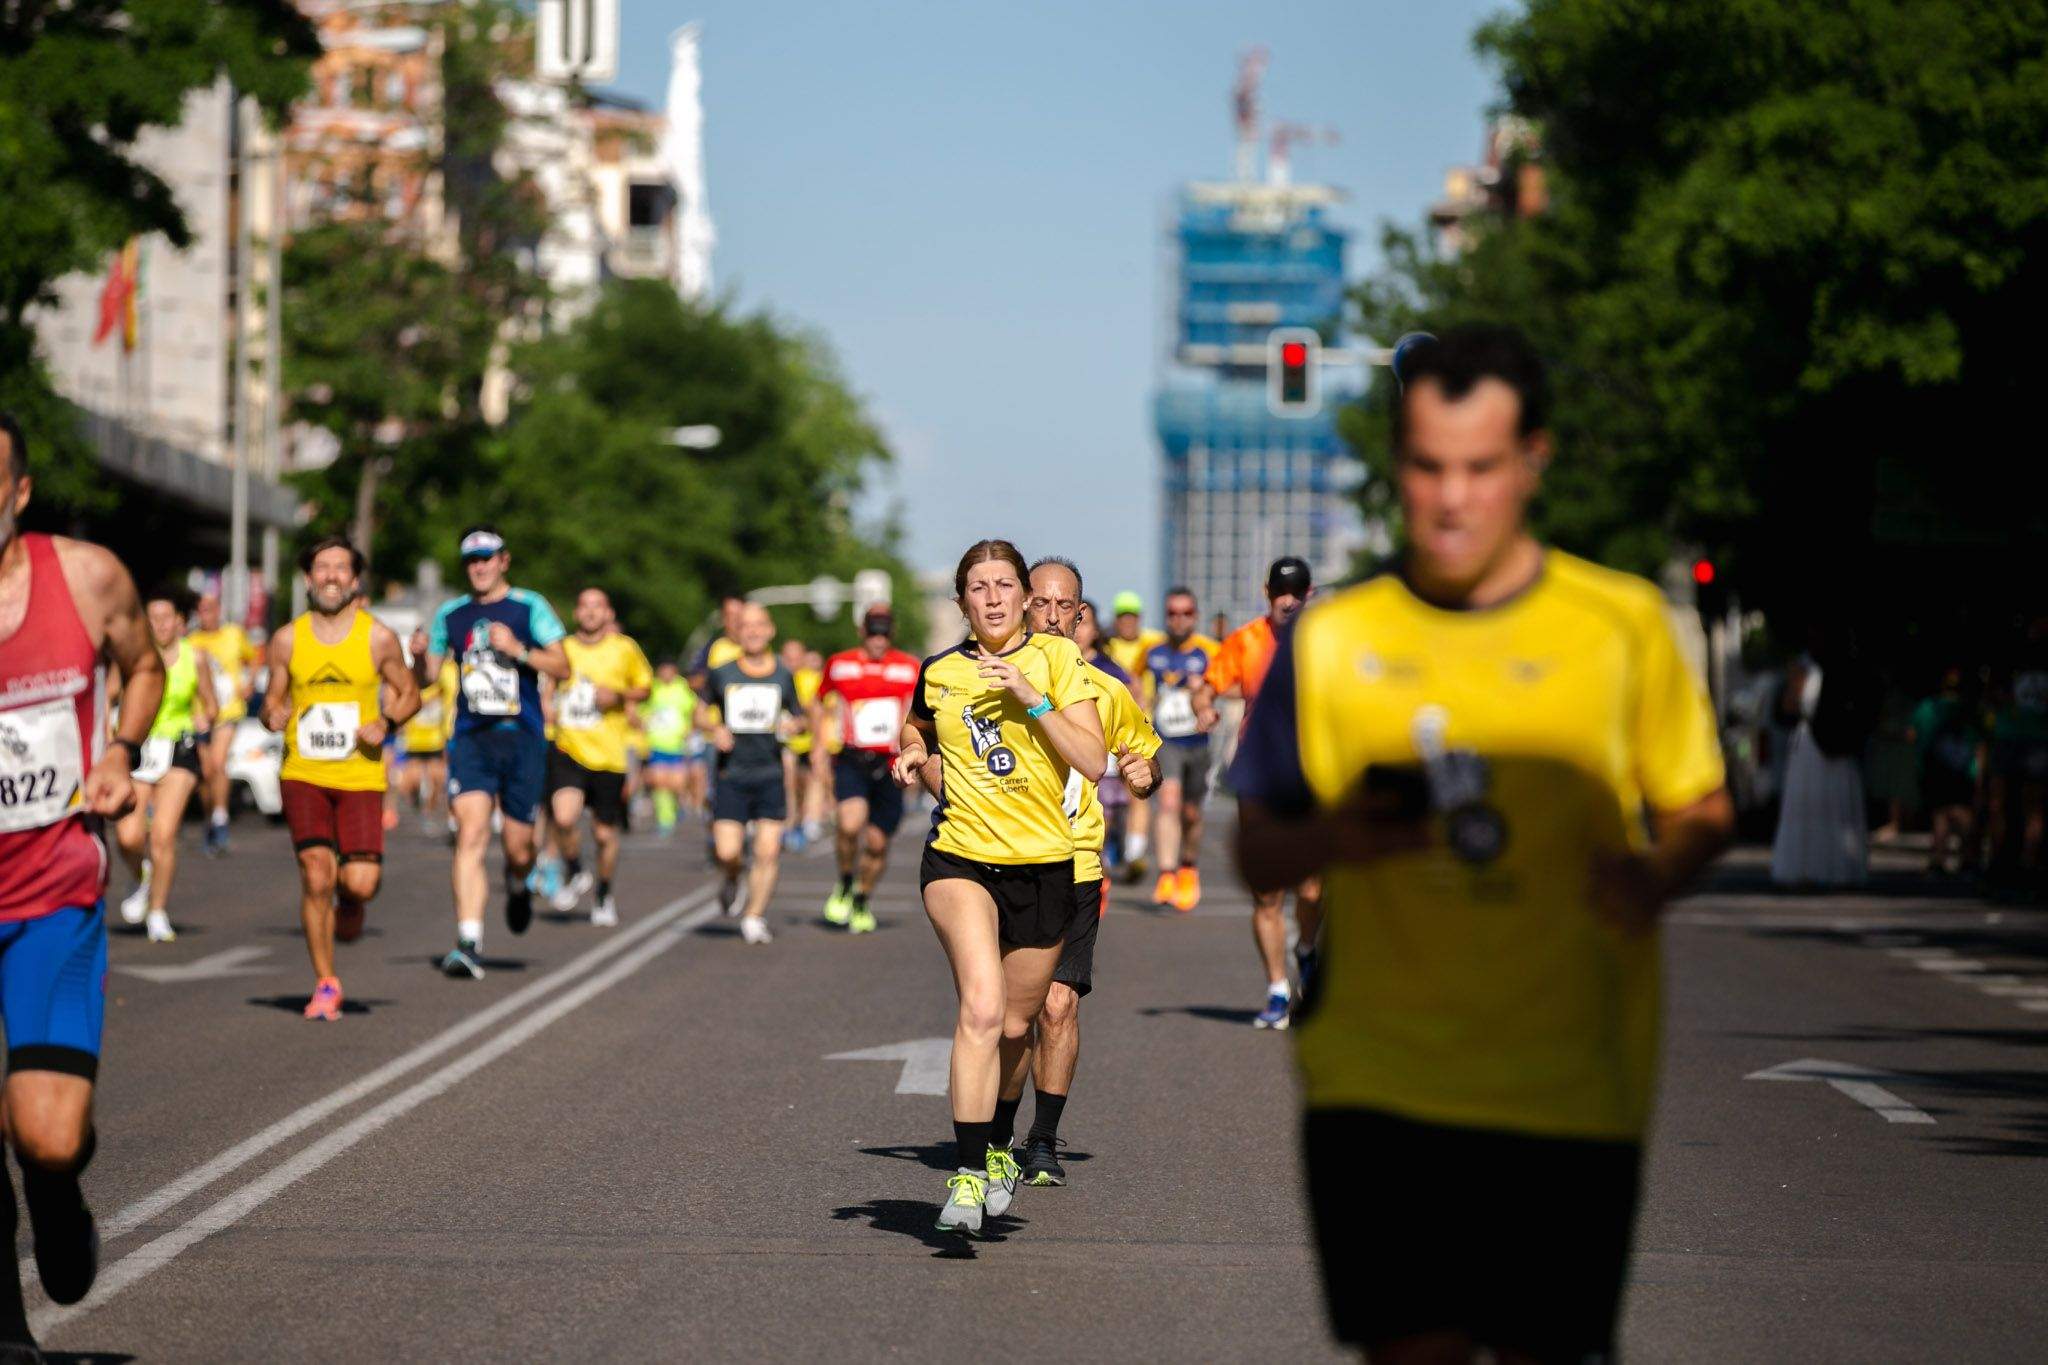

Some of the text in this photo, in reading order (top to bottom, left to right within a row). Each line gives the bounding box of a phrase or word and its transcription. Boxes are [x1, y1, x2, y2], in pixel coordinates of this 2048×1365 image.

[991, 753, 1011, 771] 13
[0, 766, 58, 807] 822
[999, 777, 1028, 786] Carrera
[1001, 785, 1029, 794] Liberty
